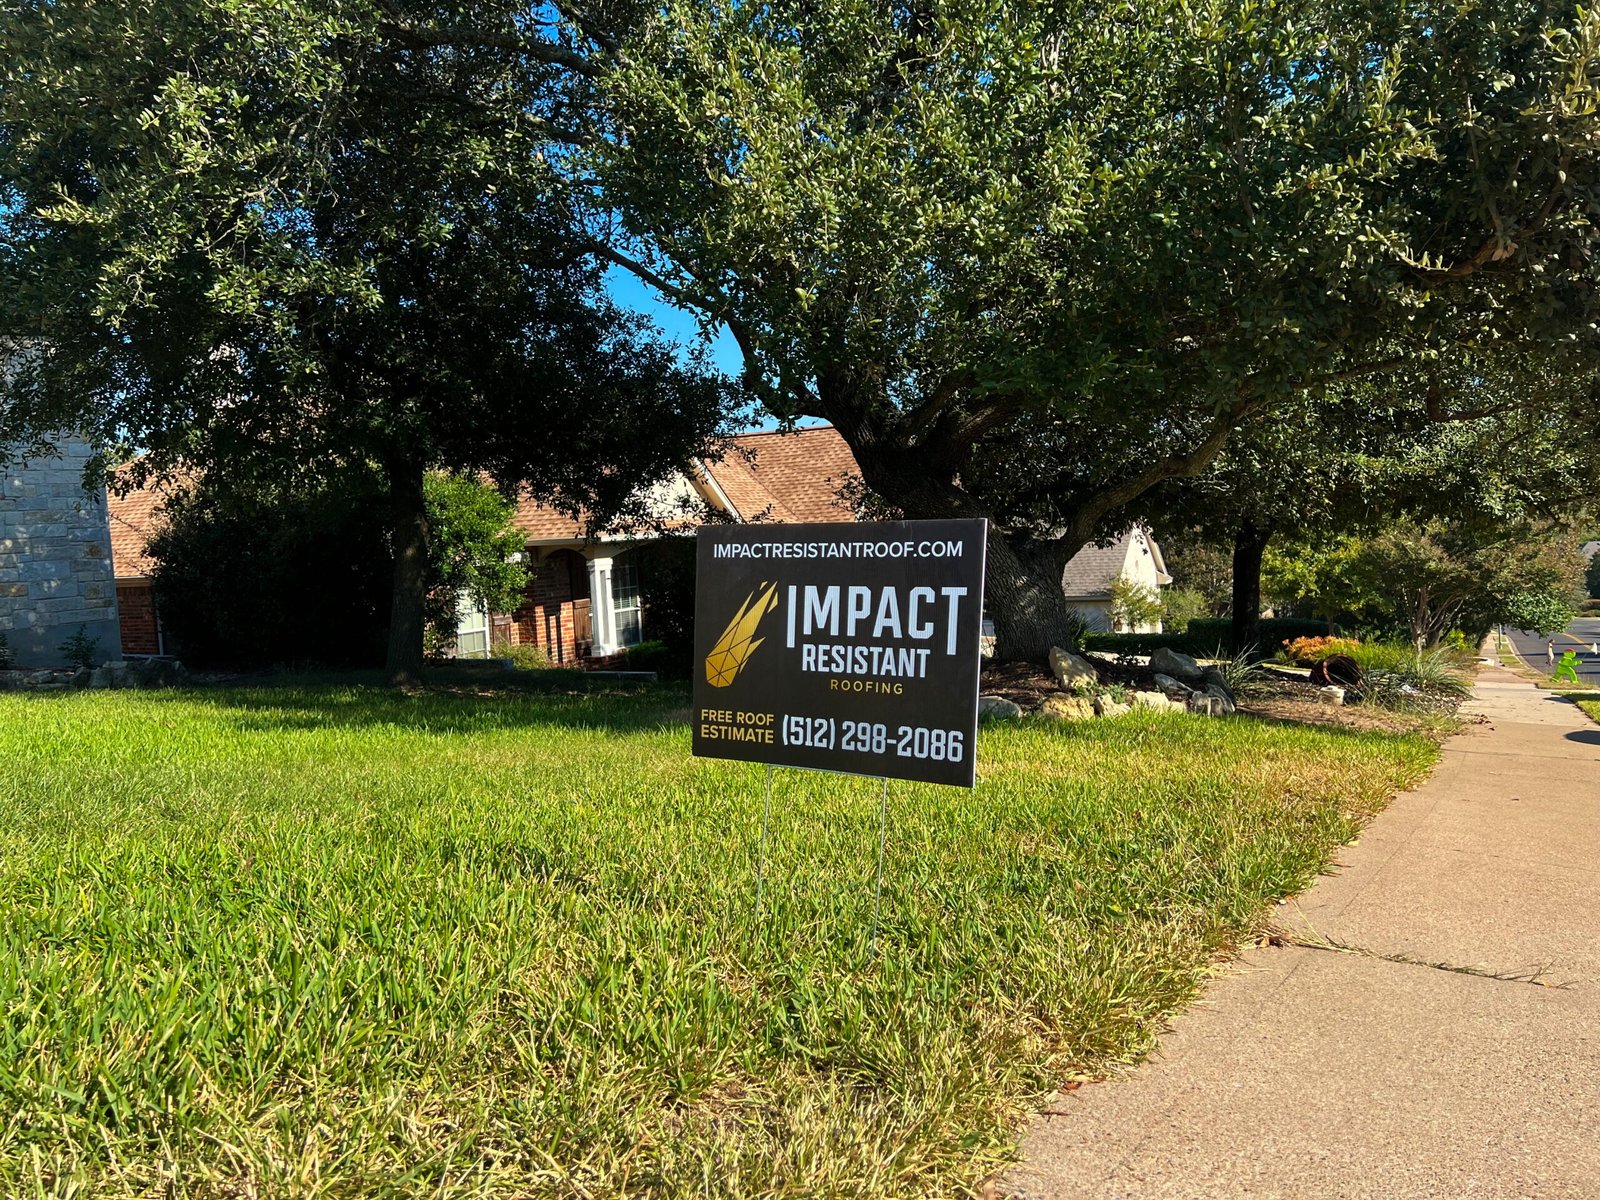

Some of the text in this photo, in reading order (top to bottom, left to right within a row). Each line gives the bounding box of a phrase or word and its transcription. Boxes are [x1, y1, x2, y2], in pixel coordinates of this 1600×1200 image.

[713, 541, 963, 558] IMPACTRESISTANTROOF.COM
[786, 585, 968, 656] IMPACT
[802, 644, 931, 678] RESISTANT
[830, 679, 903, 695] ROOFING
[701, 709, 774, 726] FREE ROOF
[700, 725, 774, 744] ESTIMATE
[782, 714, 964, 763] (512) 298-2086
